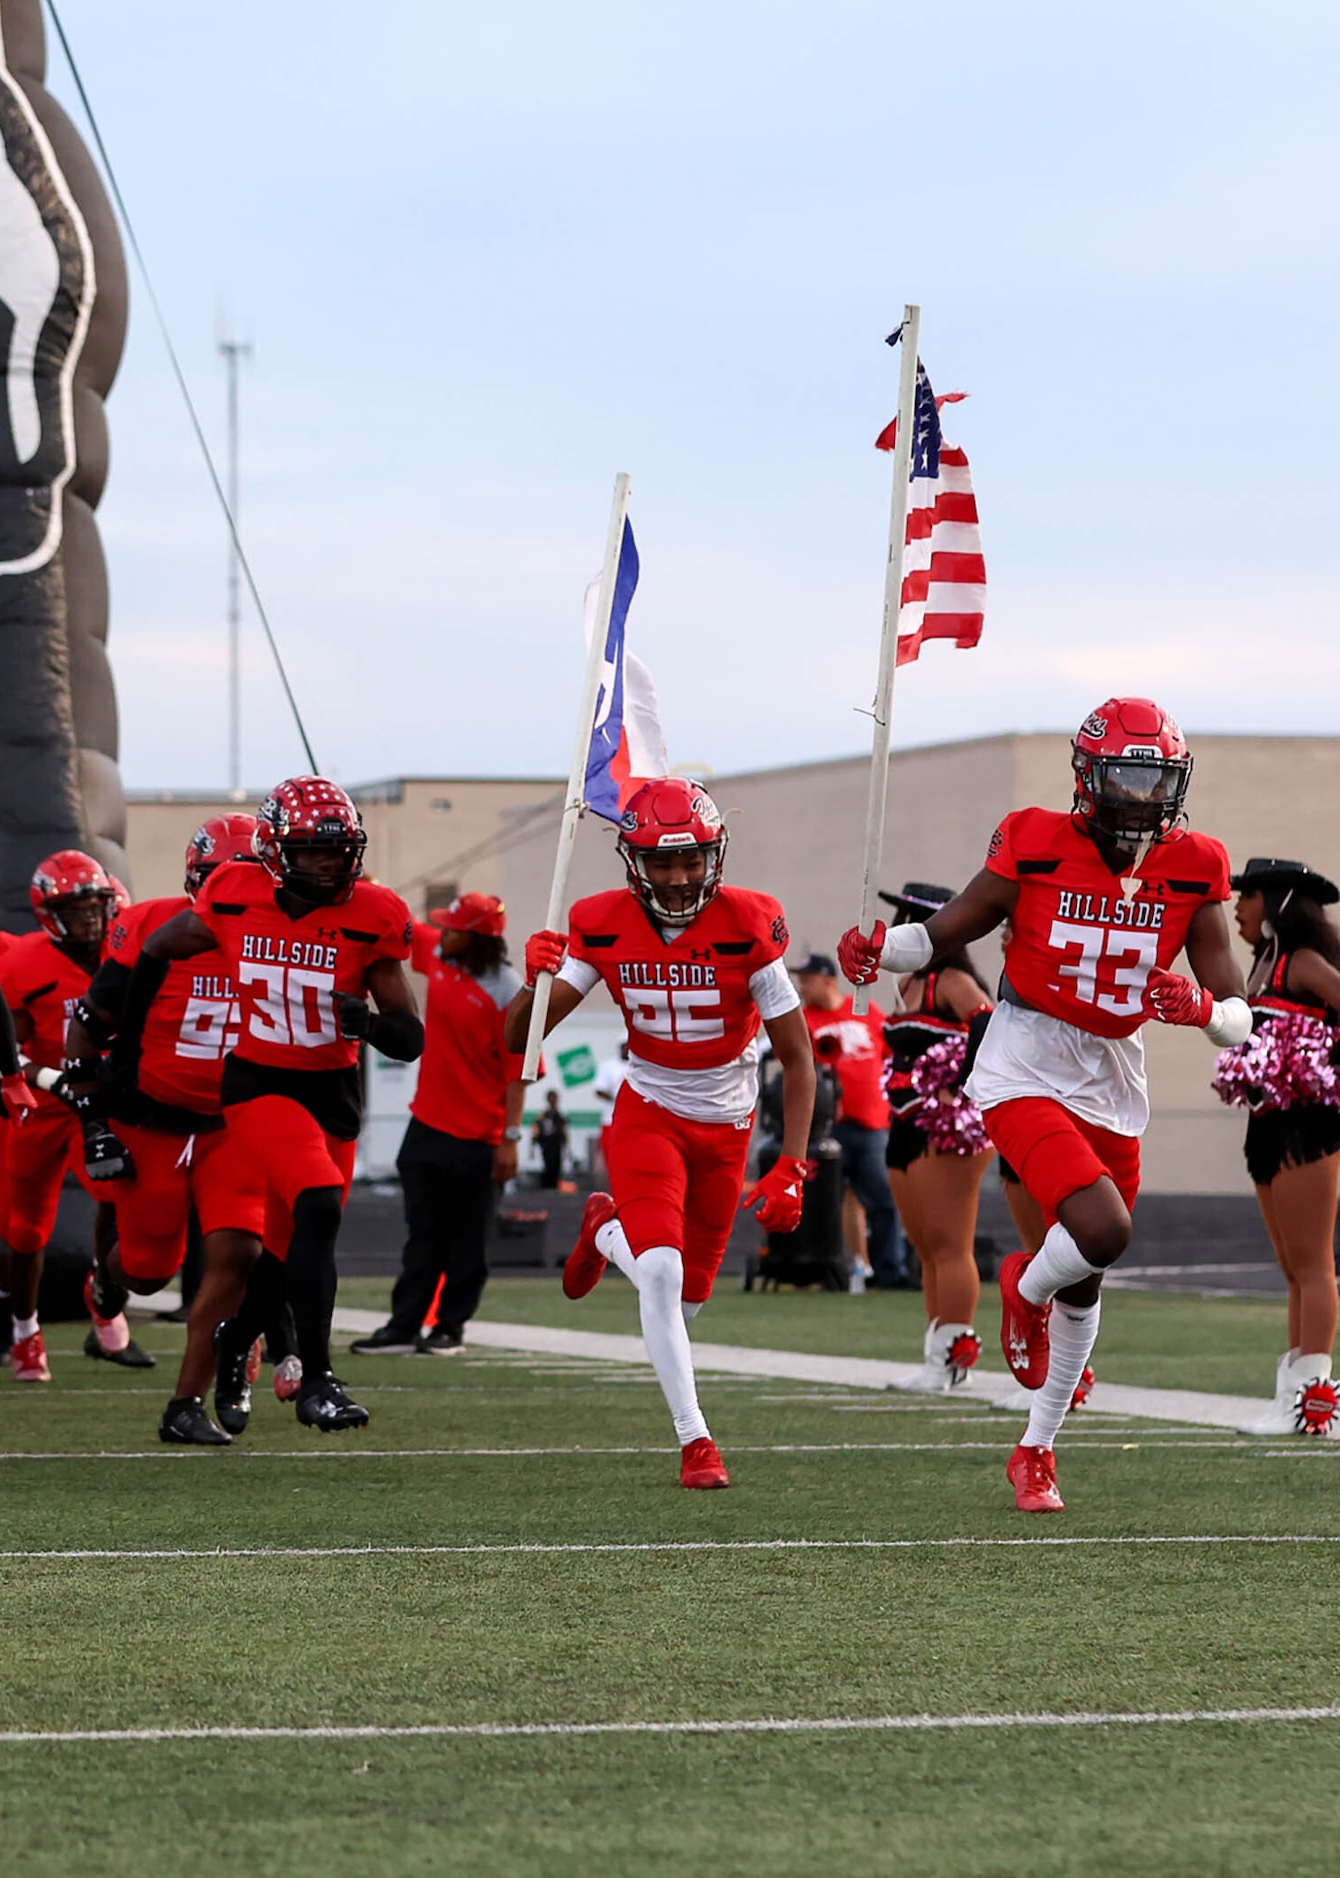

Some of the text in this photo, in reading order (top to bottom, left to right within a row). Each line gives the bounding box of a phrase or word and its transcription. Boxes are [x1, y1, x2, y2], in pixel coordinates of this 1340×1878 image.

[1057, 890, 1166, 929] HILLSIDE
[241, 934, 338, 969] HILLSIDE
[1046, 919, 1160, 1017] 33
[618, 963, 717, 987] HILLSIDE
[238, 960, 337, 1048] 30
